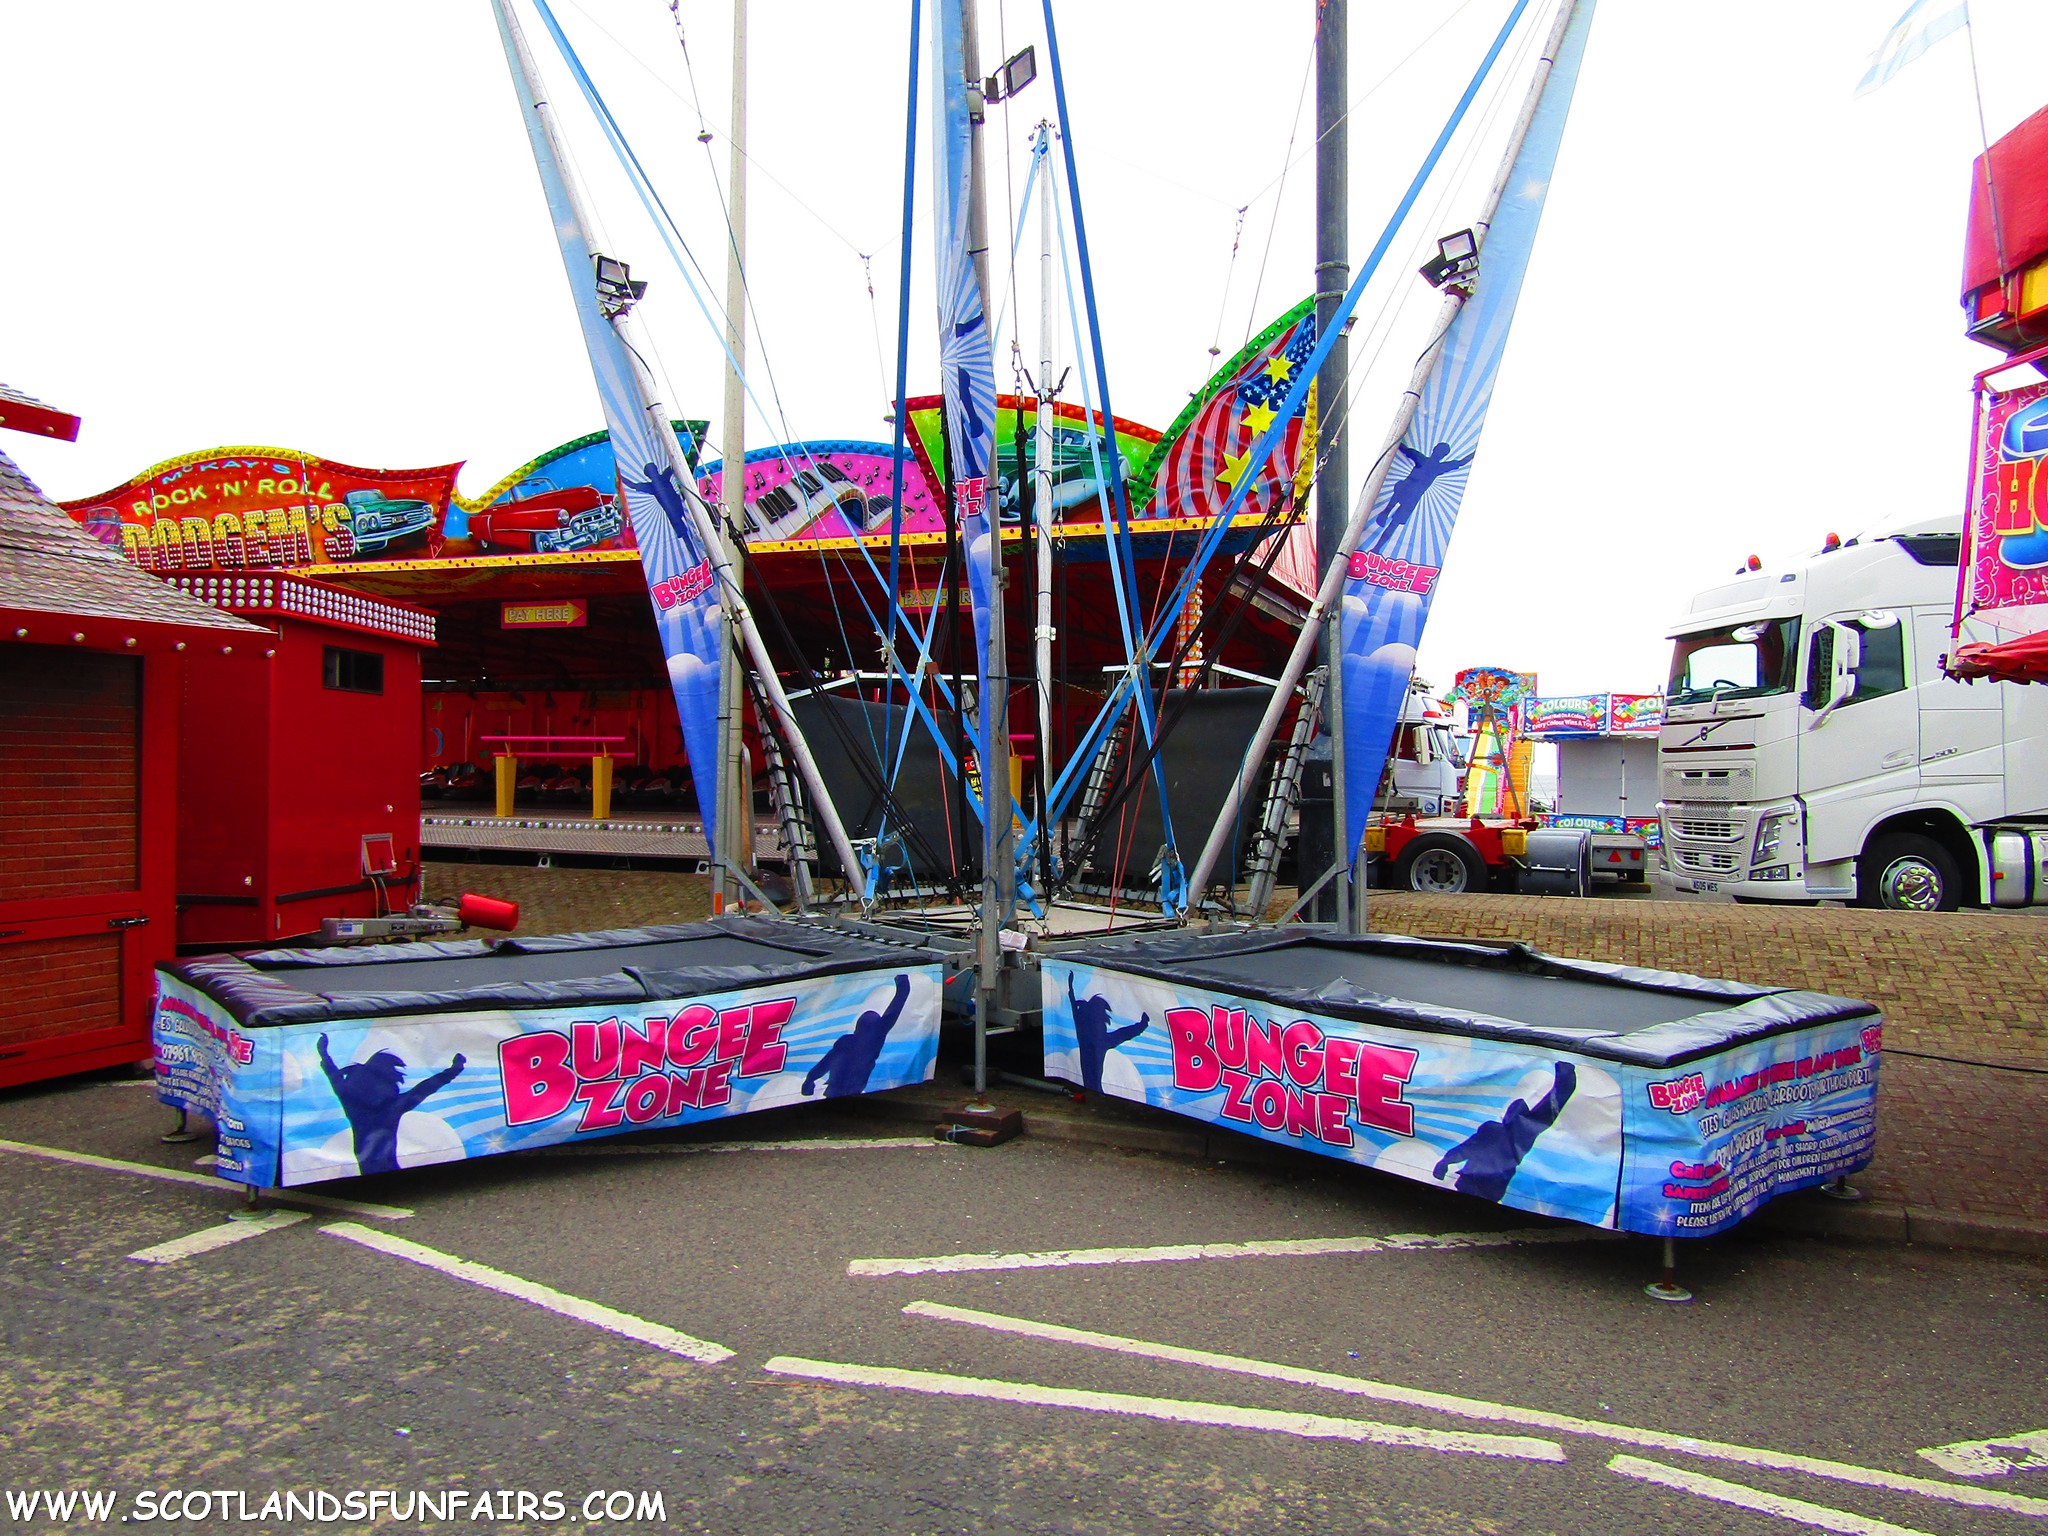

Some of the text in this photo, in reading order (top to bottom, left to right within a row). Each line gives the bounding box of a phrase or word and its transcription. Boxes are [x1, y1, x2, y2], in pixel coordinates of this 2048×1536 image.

[132, 487, 208, 517] ROCK
[258, 477, 334, 500] ROLL
[120, 502, 358, 571] DODGEM'S
[651, 556, 715, 611] BUNGEE
[1347, 549, 1441, 596] BUNGEE
[1367, 571, 1411, 592] ZONE
[677, 582, 703, 606] ZONE
[903, 591, 931, 605] PAY
[507, 606, 570, 622] PAY HERE
[1540, 698, 1589, 711] COLOURS
[1532, 721, 1547, 730] Every
[1624, 720, 1646, 729] Every
[498, 997, 797, 1128] BUNGEE
[1163, 1005, 1420, 1141] BUNGEE
[574, 1057, 736, 1133] ZONE
[1648, 1073, 1707, 1108] BUNGEE
[1219, 1058, 1356, 1150] ZONE
[1672, 1097, 1701, 1114] ZONE
[1794, 1140, 1818, 1153] SHARP
[1669, 1160, 1704, 1180] Call
[1676, 1214, 1709, 1227] PLEASE
